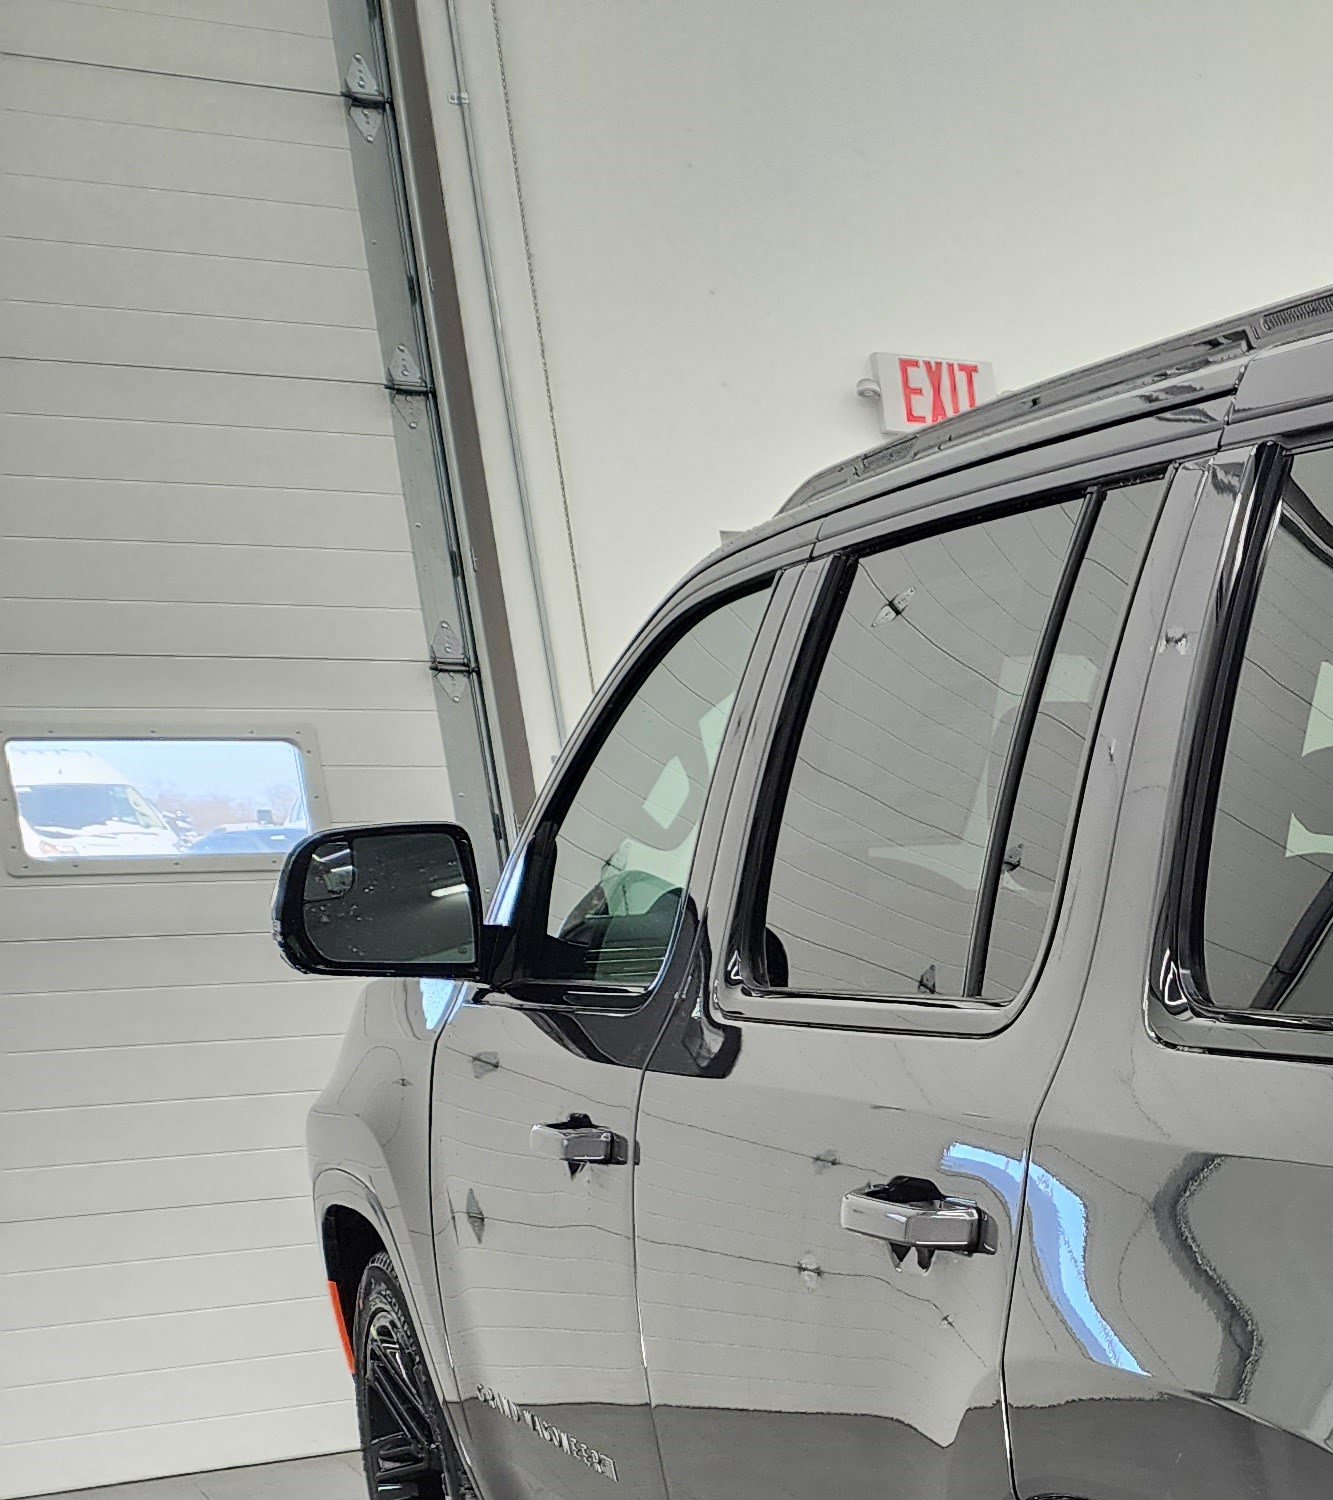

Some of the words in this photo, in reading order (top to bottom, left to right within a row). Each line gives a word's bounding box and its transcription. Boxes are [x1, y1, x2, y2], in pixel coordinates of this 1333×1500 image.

[898, 356, 980, 425] EXIT
[476, 1383, 521, 1422] GRAND
[522, 1408, 602, 1474] WAGONEER
